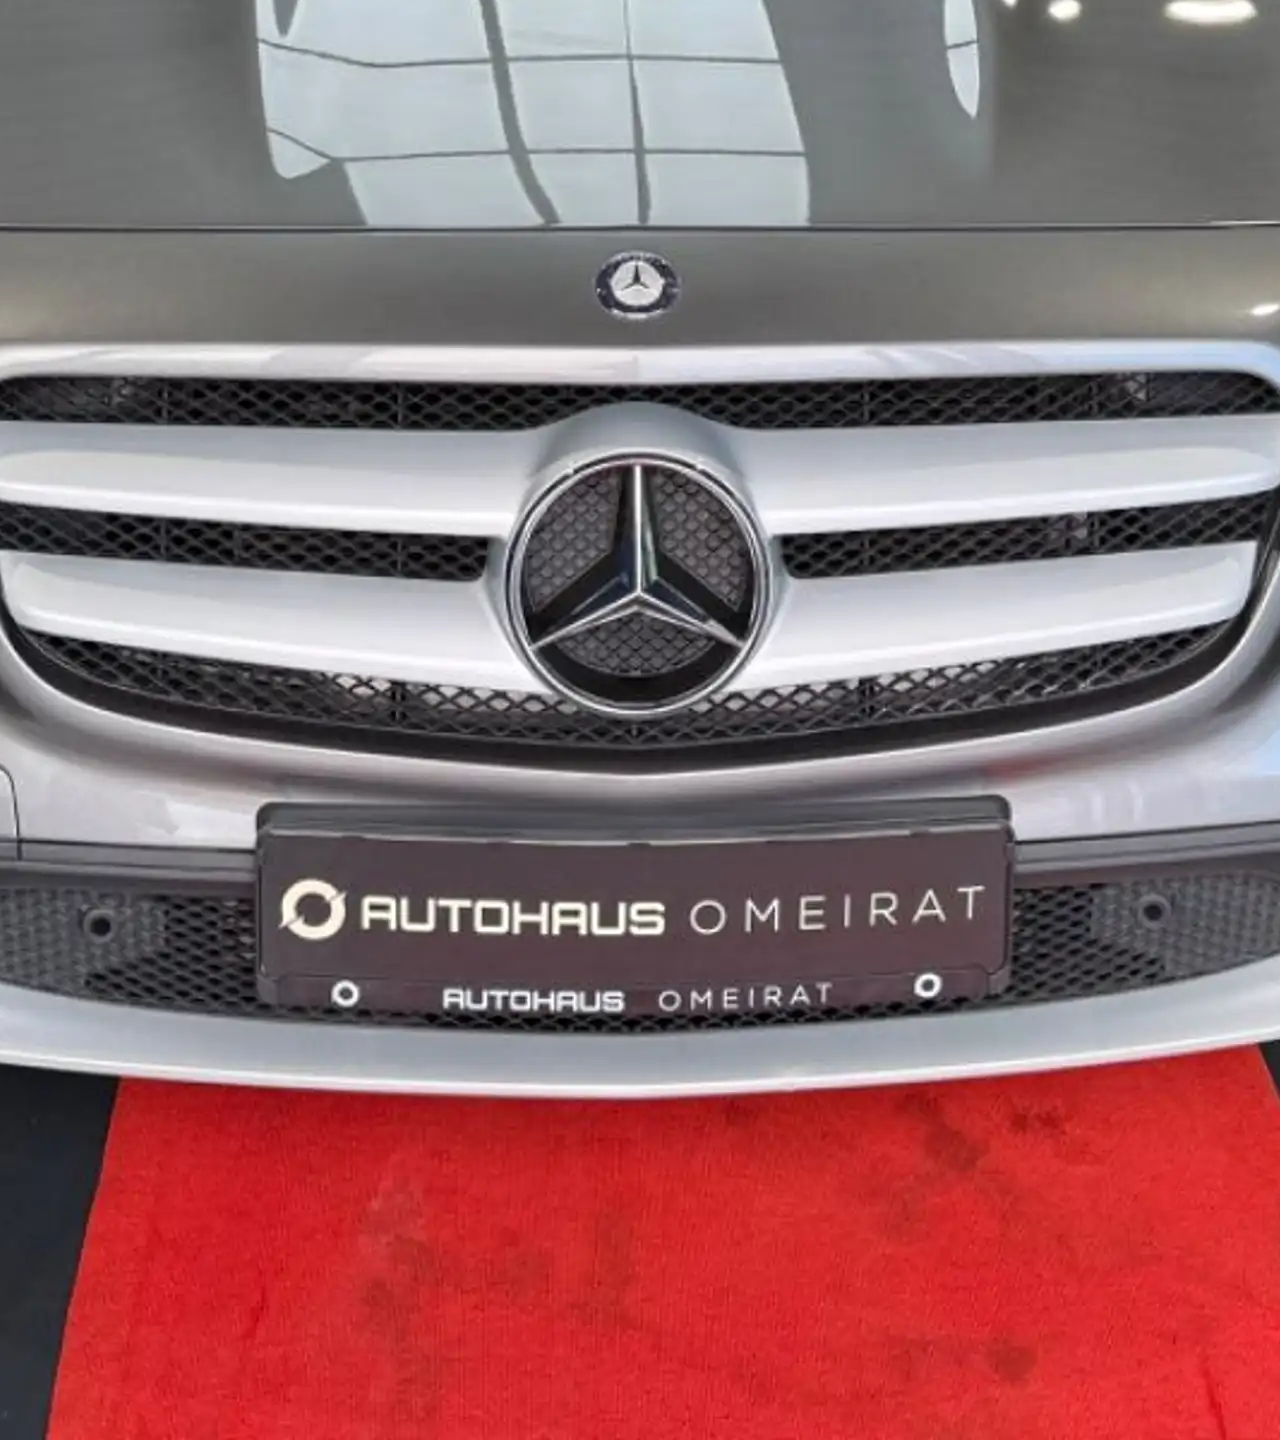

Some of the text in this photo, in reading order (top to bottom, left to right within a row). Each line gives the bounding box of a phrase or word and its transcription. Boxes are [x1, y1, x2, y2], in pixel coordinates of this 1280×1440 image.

[360, 885, 986, 936] AUTOHAUS OMEIRAT
[441, 981, 834, 1013] AUTOHAUS OMEIRAT
